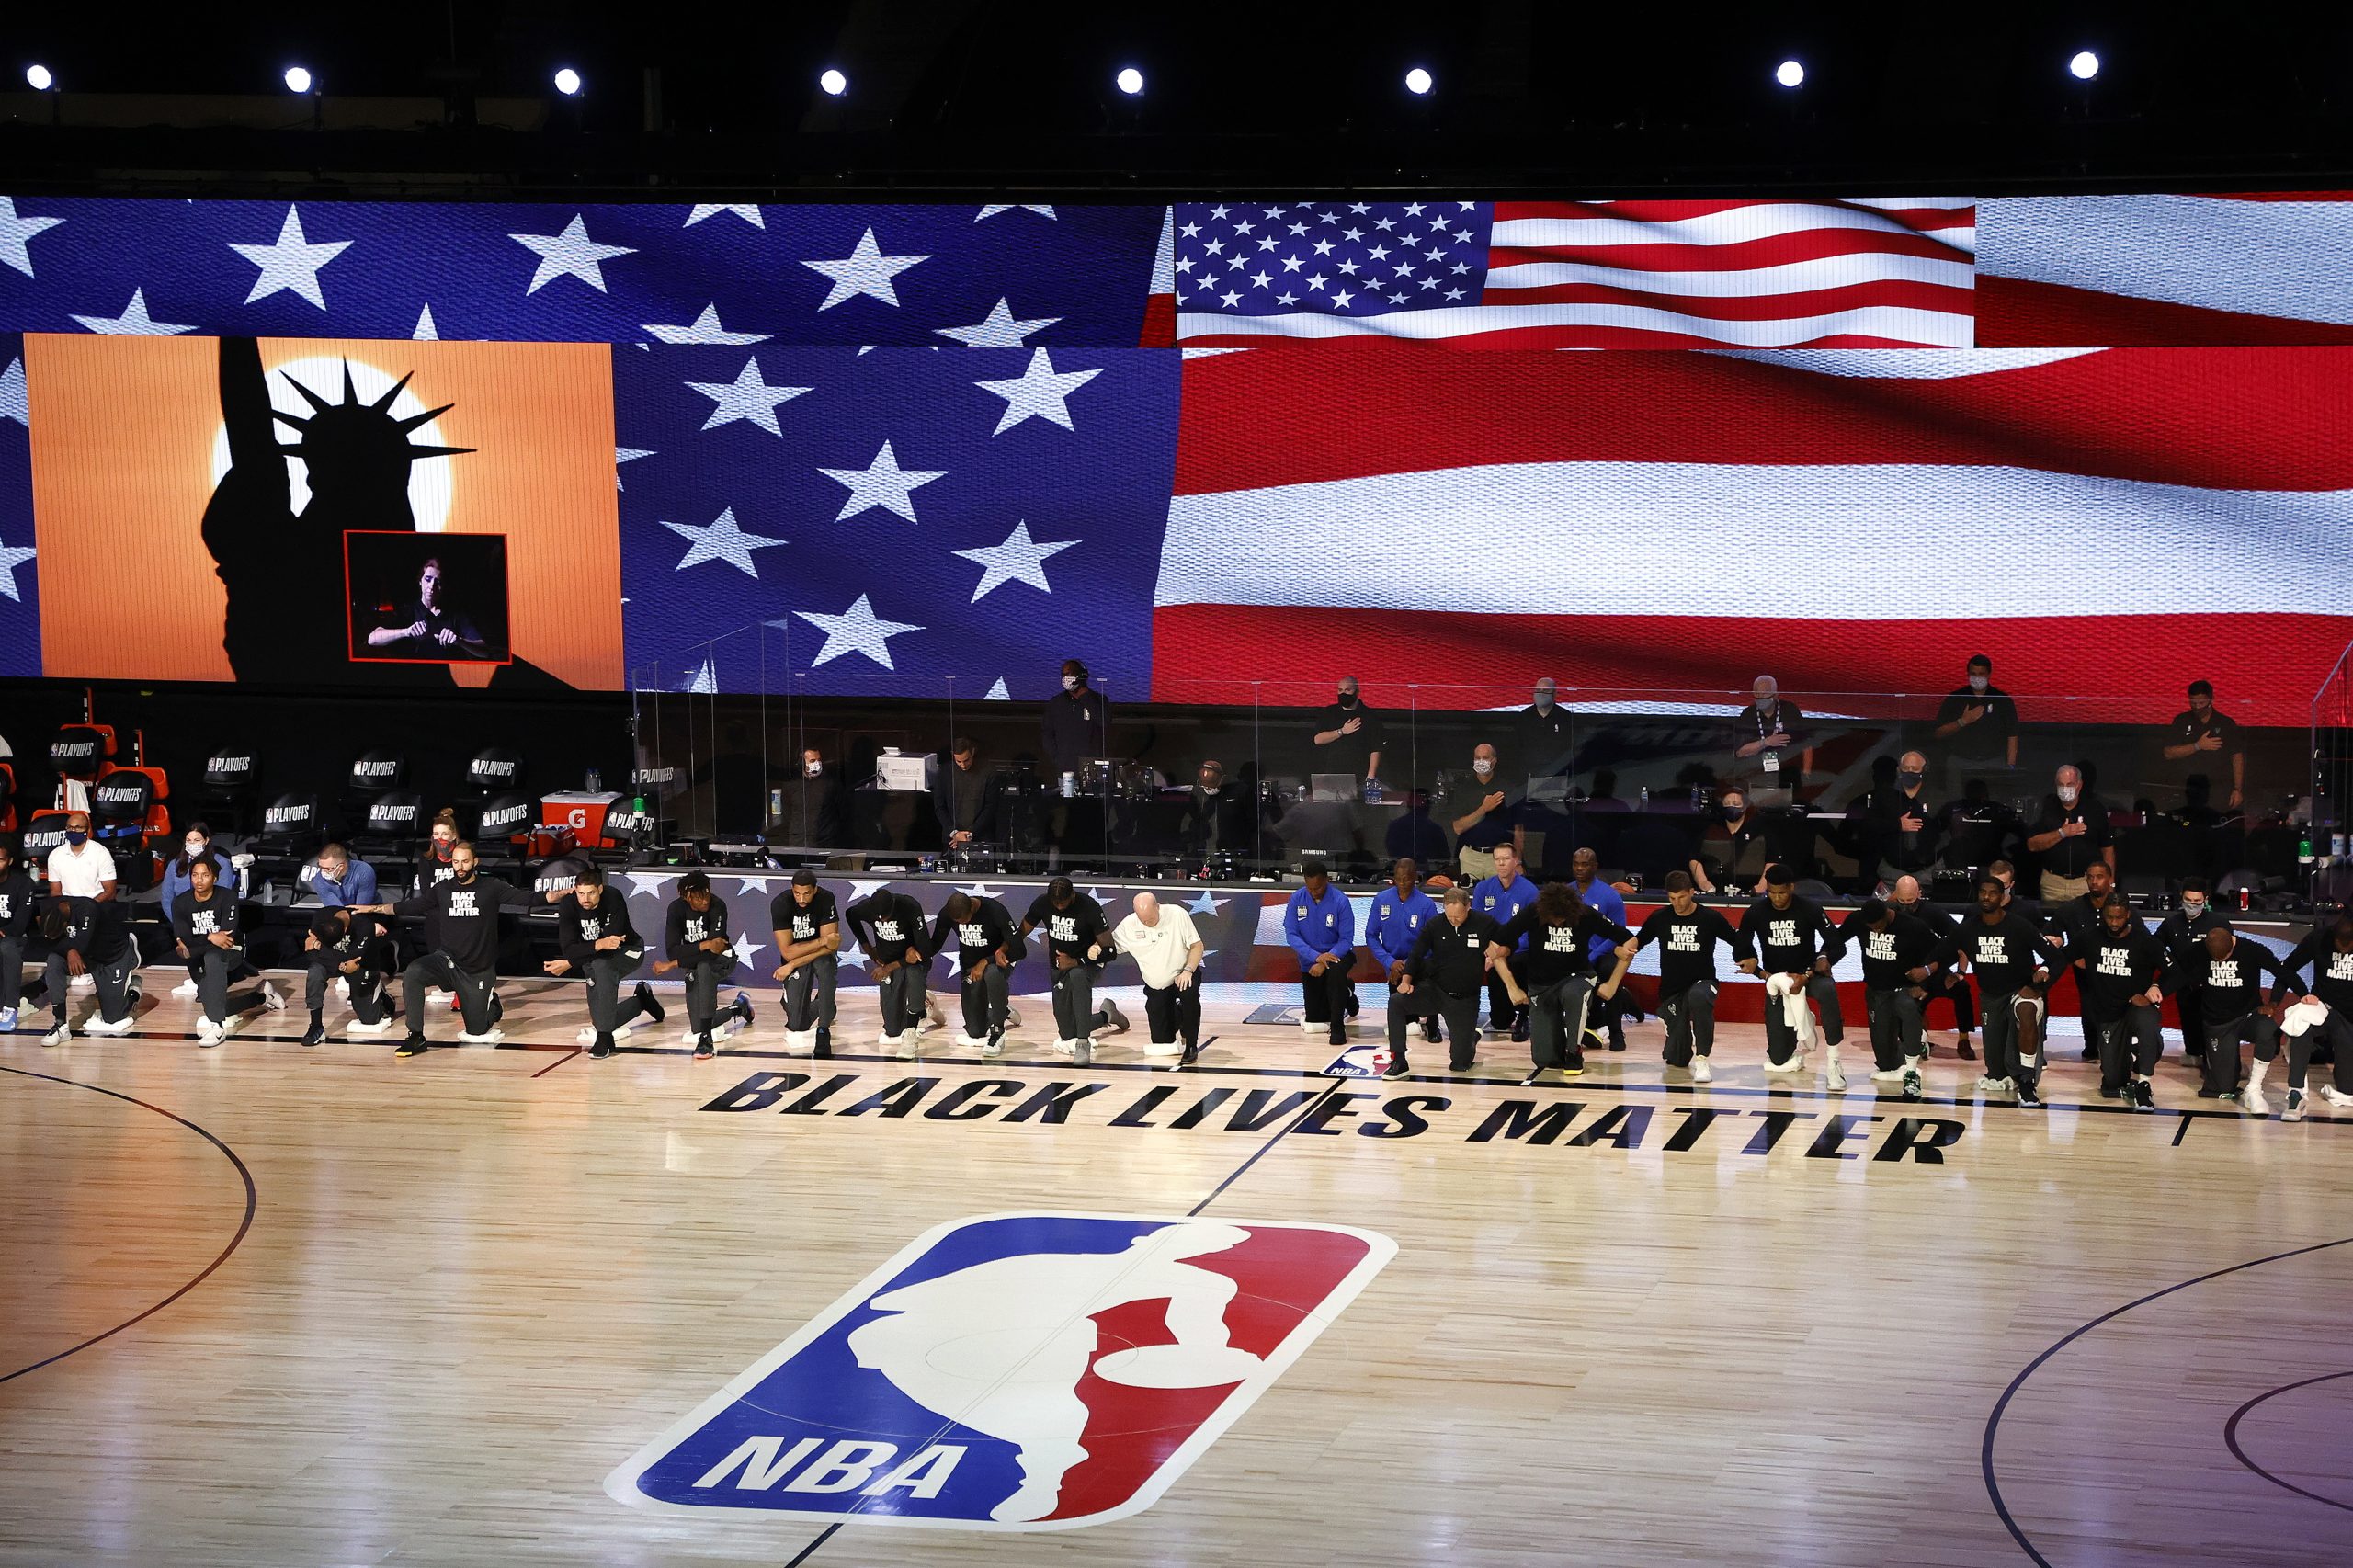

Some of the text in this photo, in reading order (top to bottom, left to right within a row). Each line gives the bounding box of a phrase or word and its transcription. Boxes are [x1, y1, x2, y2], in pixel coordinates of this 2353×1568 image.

[58, 743, 94, 756] PLAYOFFS
[215, 756, 250, 771] PLAYOFFS
[361, 761, 396, 776] PLAYOFFS
[479, 759, 515, 776] PLAYOFFS
[104, 787, 142, 801] PLAYOFFS
[273, 804, 309, 823] PLAYOFFS
[378, 805, 415, 820] PLAYOFFS
[491, 804, 527, 825] PLAYOFFS
[568, 809, 585, 828] G
[616, 813, 654, 831] PLAYFFS
[32, 830, 67, 847] PLAYOFF
[543, 875, 577, 892] PLAYOFF
[451, 891, 476, 901] BLACK
[453, 900, 473, 908] LIVES
[191, 910, 216, 921] BLACK
[449, 907, 480, 916] MATTER
[195, 919, 215, 928] LIVES
[874, 920, 898, 929] BLACK
[1051, 915, 1076, 927] BLACK
[1769, 920, 1796, 930] BLACK
[877, 927, 898, 937] LIVES
[959, 924, 983, 932] BLACK
[1053, 923, 1073, 934] LIVES
[1548, 926, 1573, 937] BLACK
[1671, 925, 1698, 935] BLACK
[1772, 929, 1794, 937] LIVES
[961, 931, 982, 939] LIVES
[1049, 929, 1078, 941] MATTER
[1550, 935, 1571, 945] LIVES
[1673, 934, 1695, 943] LIVES
[1869, 931, 1895, 944] BLACK
[1544, 941, 1575, 952] MATTER
[1667, 941, 1700, 951] MATTER
[1768, 937, 1801, 946] MATTER
[1870, 940, 1893, 951] LIVES
[1978, 936, 2005, 946] BLACK
[1865, 948, 1897, 960] MATTER
[1980, 946, 2002, 955] LIVES
[2101, 947, 2129, 959] BLACK
[1976, 954, 2008, 963] MATTER
[2102, 956, 2126, 967] LIVES
[2332, 952, 2353, 963] BLAC
[2097, 963, 2131, 976] MATTER
[2210, 961, 2238, 971] BLACK
[2333, 961, 2353, 972] LIVE
[2211, 970, 2235, 979] LIVES
[2326, 968, 2353, 981] MATT
[2208, 977, 2243, 987] MATTER
[697, 1071, 1966, 1164] BLACK LIVES MATTER
[691, 1436, 969, 1498] NBA
